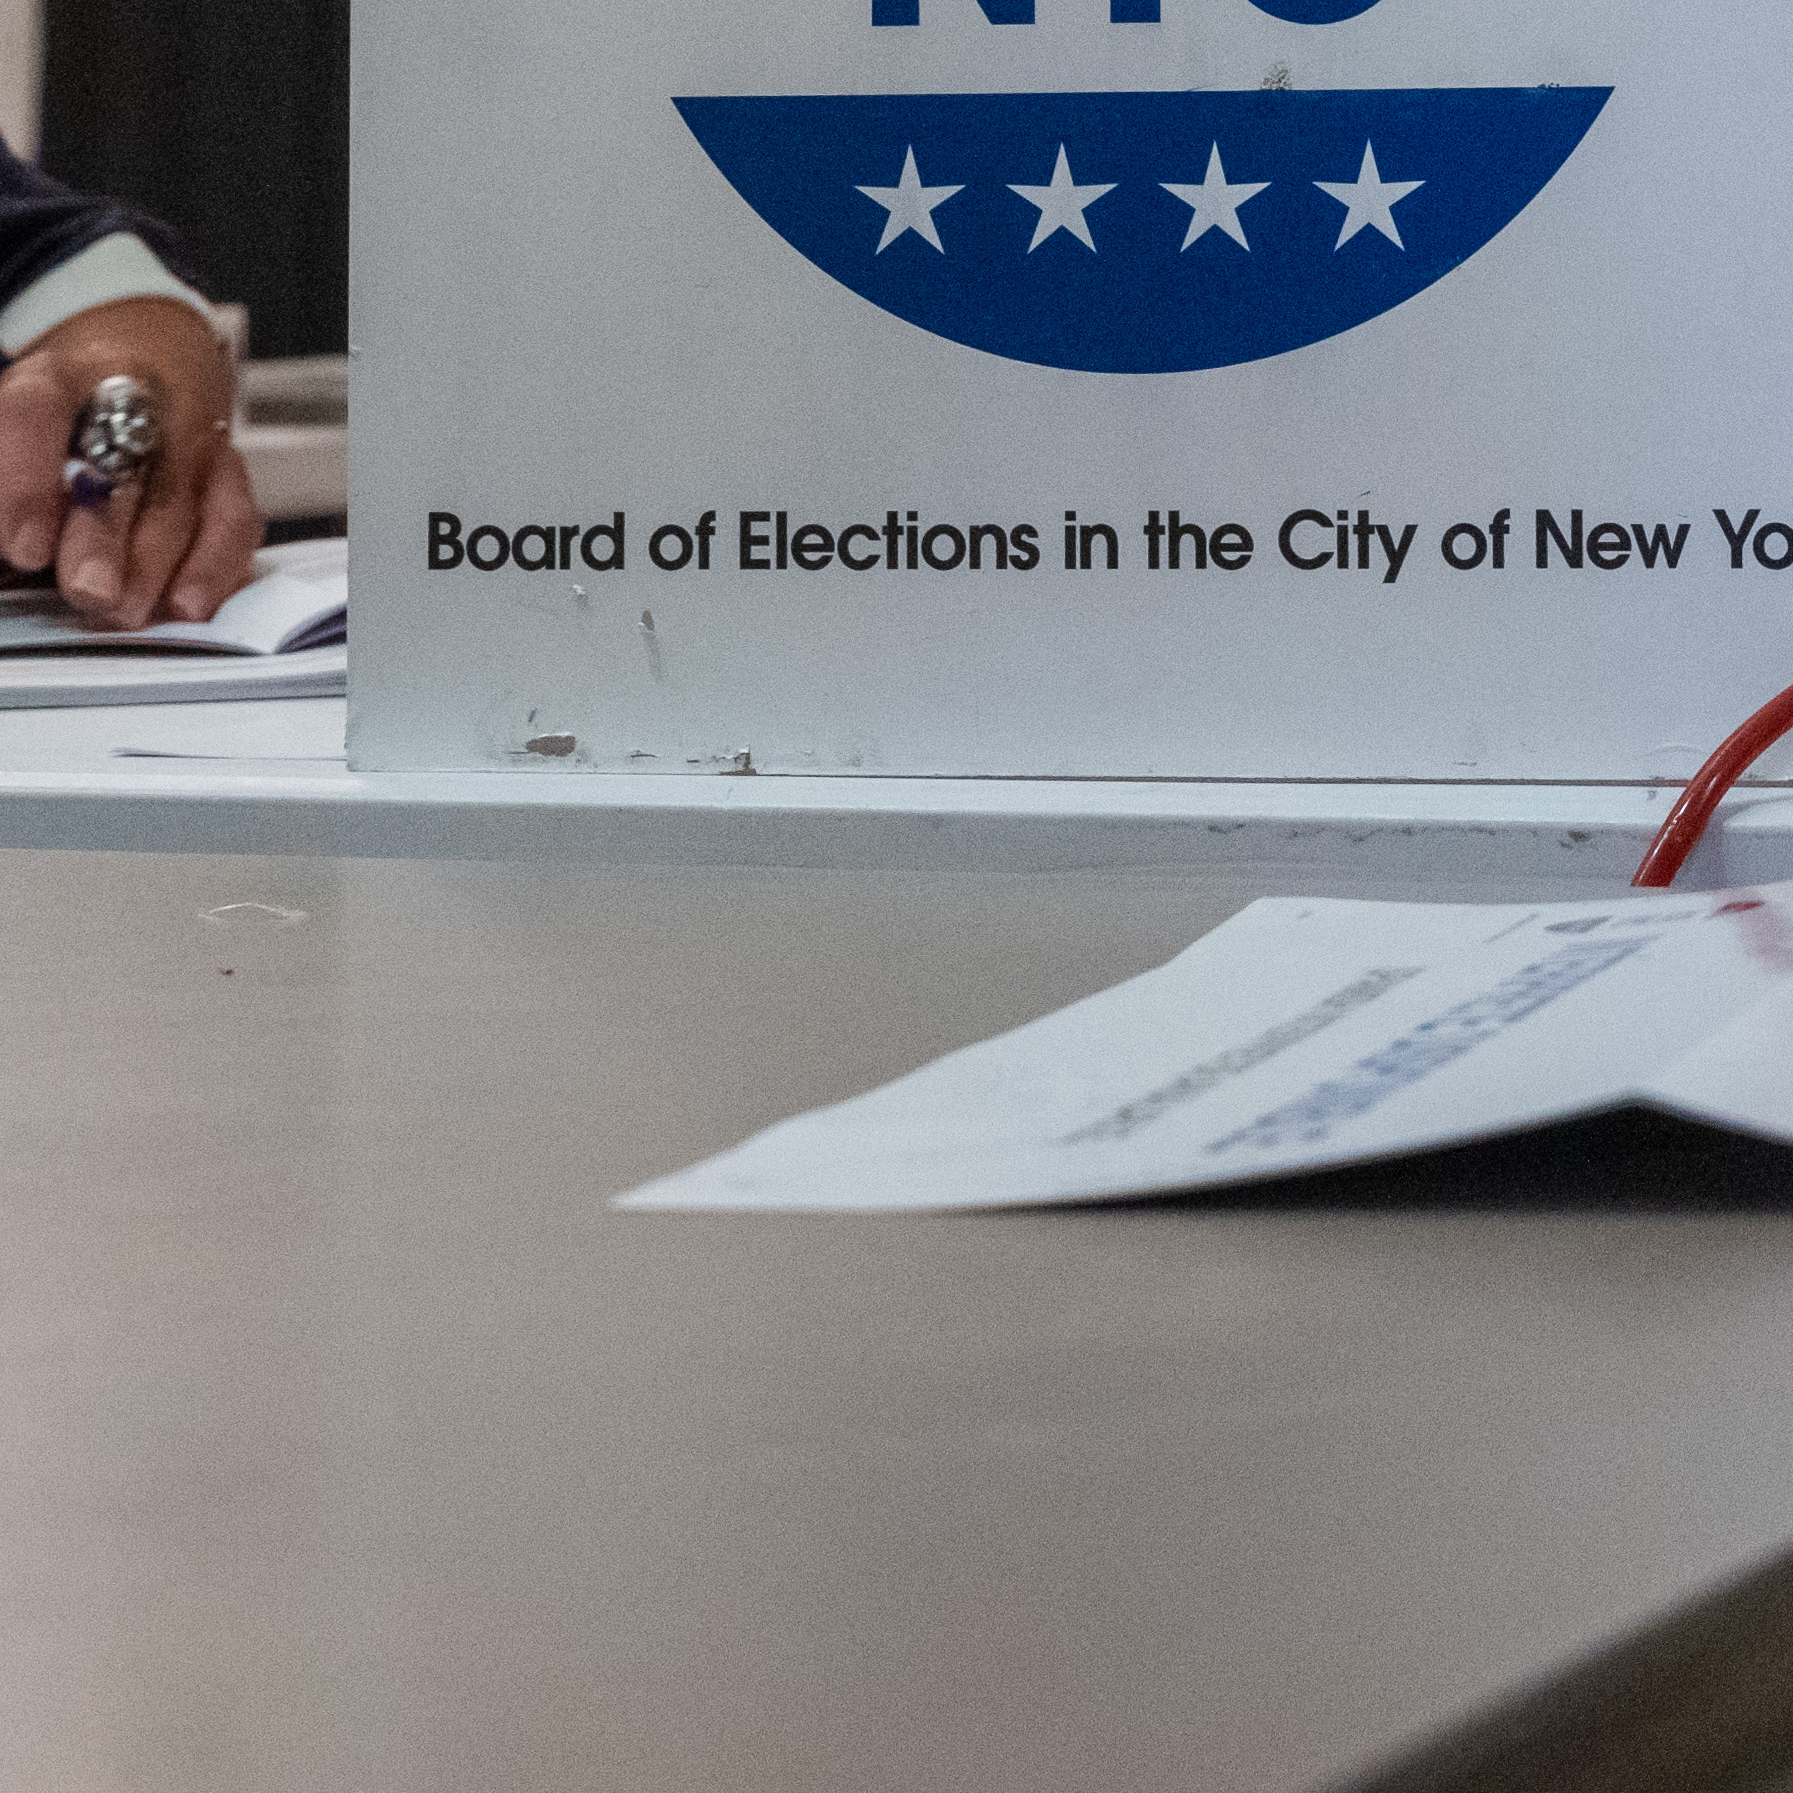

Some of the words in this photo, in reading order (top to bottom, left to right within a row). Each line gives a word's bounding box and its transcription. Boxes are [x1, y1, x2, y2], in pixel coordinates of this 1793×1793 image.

[427, 511, 625, 571] Board
[648, 509, 717, 572] of
[738, 510, 1041, 572] Elections
[1063, 509, 1120, 570] in
[1143, 508, 1255, 571] the
[1277, 507, 1419, 584] City
[1440, 507, 1512, 571] of
[1534, 508, 1692, 570] New
